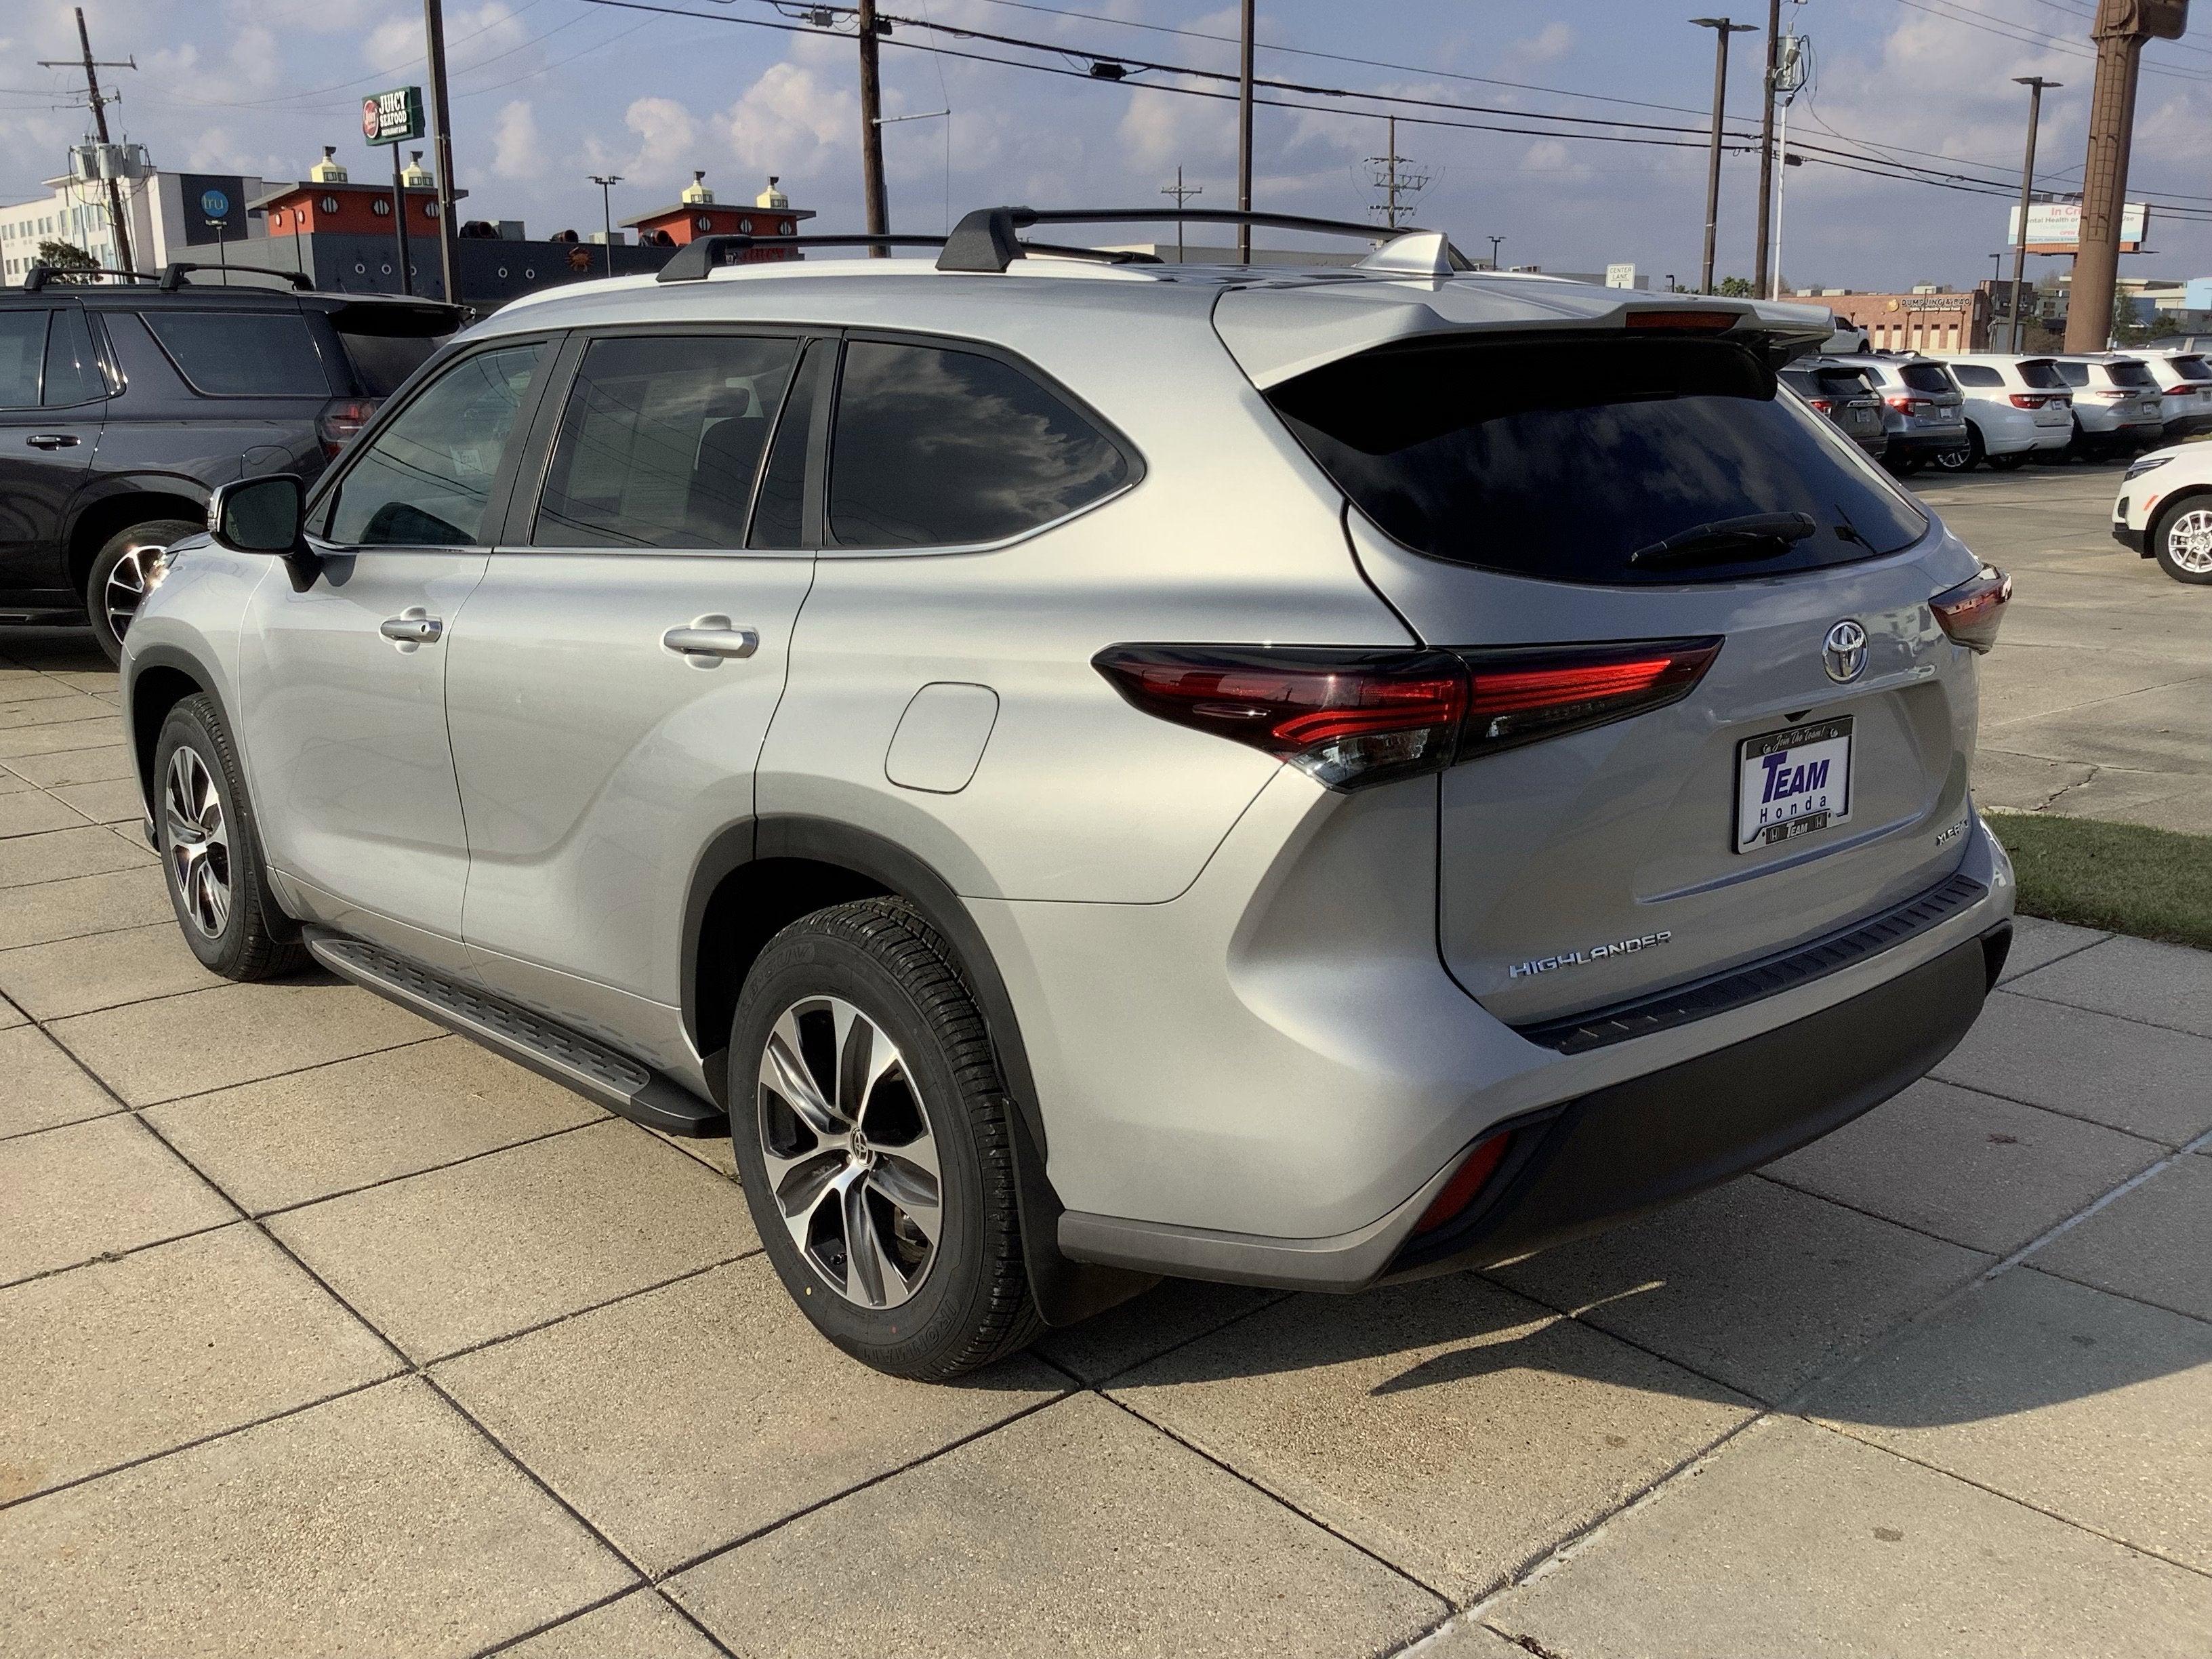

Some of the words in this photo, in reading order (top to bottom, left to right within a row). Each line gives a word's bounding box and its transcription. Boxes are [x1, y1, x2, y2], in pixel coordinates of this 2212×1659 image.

[378, 90, 405, 115] JUICY
[380, 110, 407, 127] SEAFOOD
[202, 195, 224, 210] tru
[2051, 207, 2062, 216] In
[1902, 298, 1944, 306] DUMPLING
[1954, 298, 1971, 306] BAO
[1772, 734, 1790, 752] Join
[1791, 730, 1803, 745] The
[1803, 726, 1826, 741] Team!
[1761, 751, 1830, 804] TEAM
[1759, 795, 1827, 823] Honda
[1786, 821, 1809, 838] TEAM
[1509, 930, 1672, 979] HIGHLANDER
[861, 1298, 962, 1364] IRONMAN
